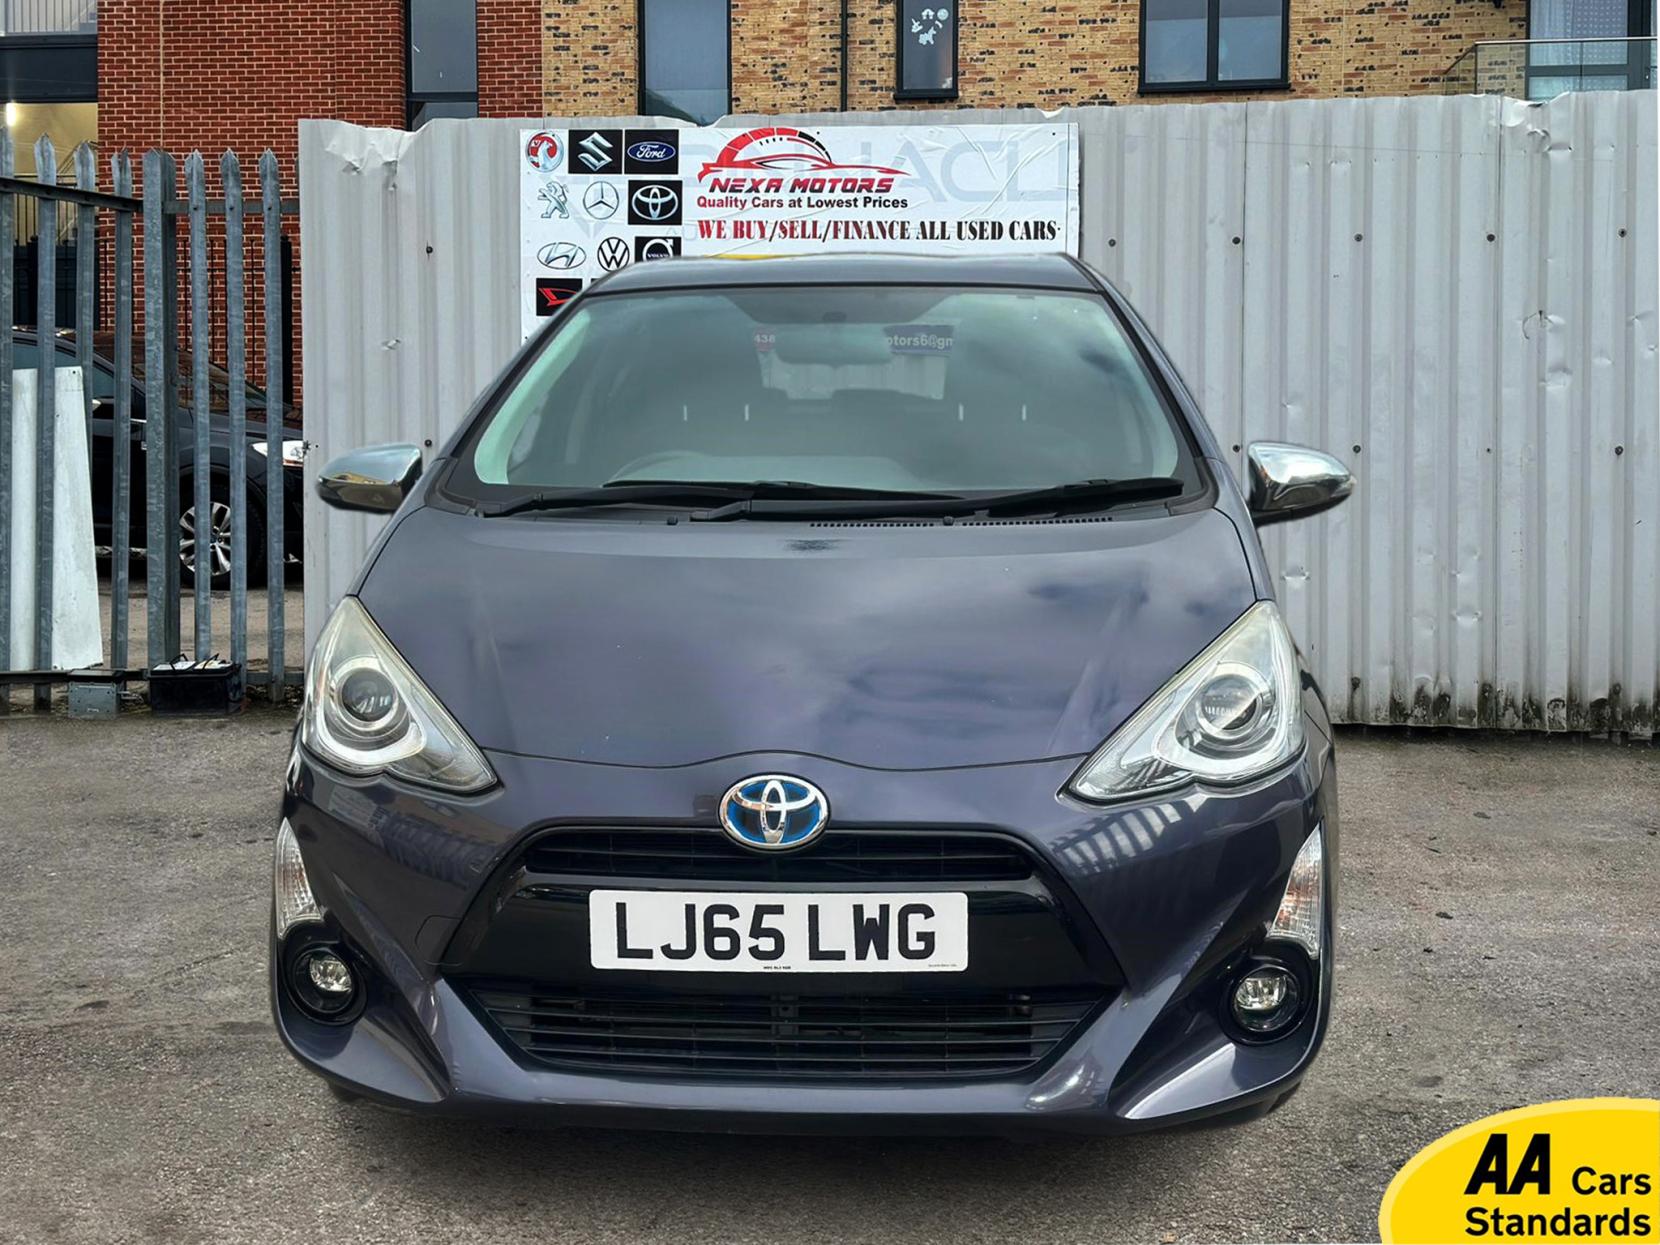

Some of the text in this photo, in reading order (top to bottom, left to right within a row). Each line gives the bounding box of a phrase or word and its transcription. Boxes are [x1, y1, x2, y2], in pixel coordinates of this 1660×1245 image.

[636, 145, 666, 159] Ford
[708, 177, 896, 193] NEXA MOTORS
[696, 196, 908, 210] Quality Cars at Lowest Prices
[696, 220, 727, 240] WE
[915, 220, 951, 241] ALL
[956, 220, 1004, 241] USED
[1008, 220, 1057, 241] CARS
[615, 902, 936, 961] LJ65 LWG
